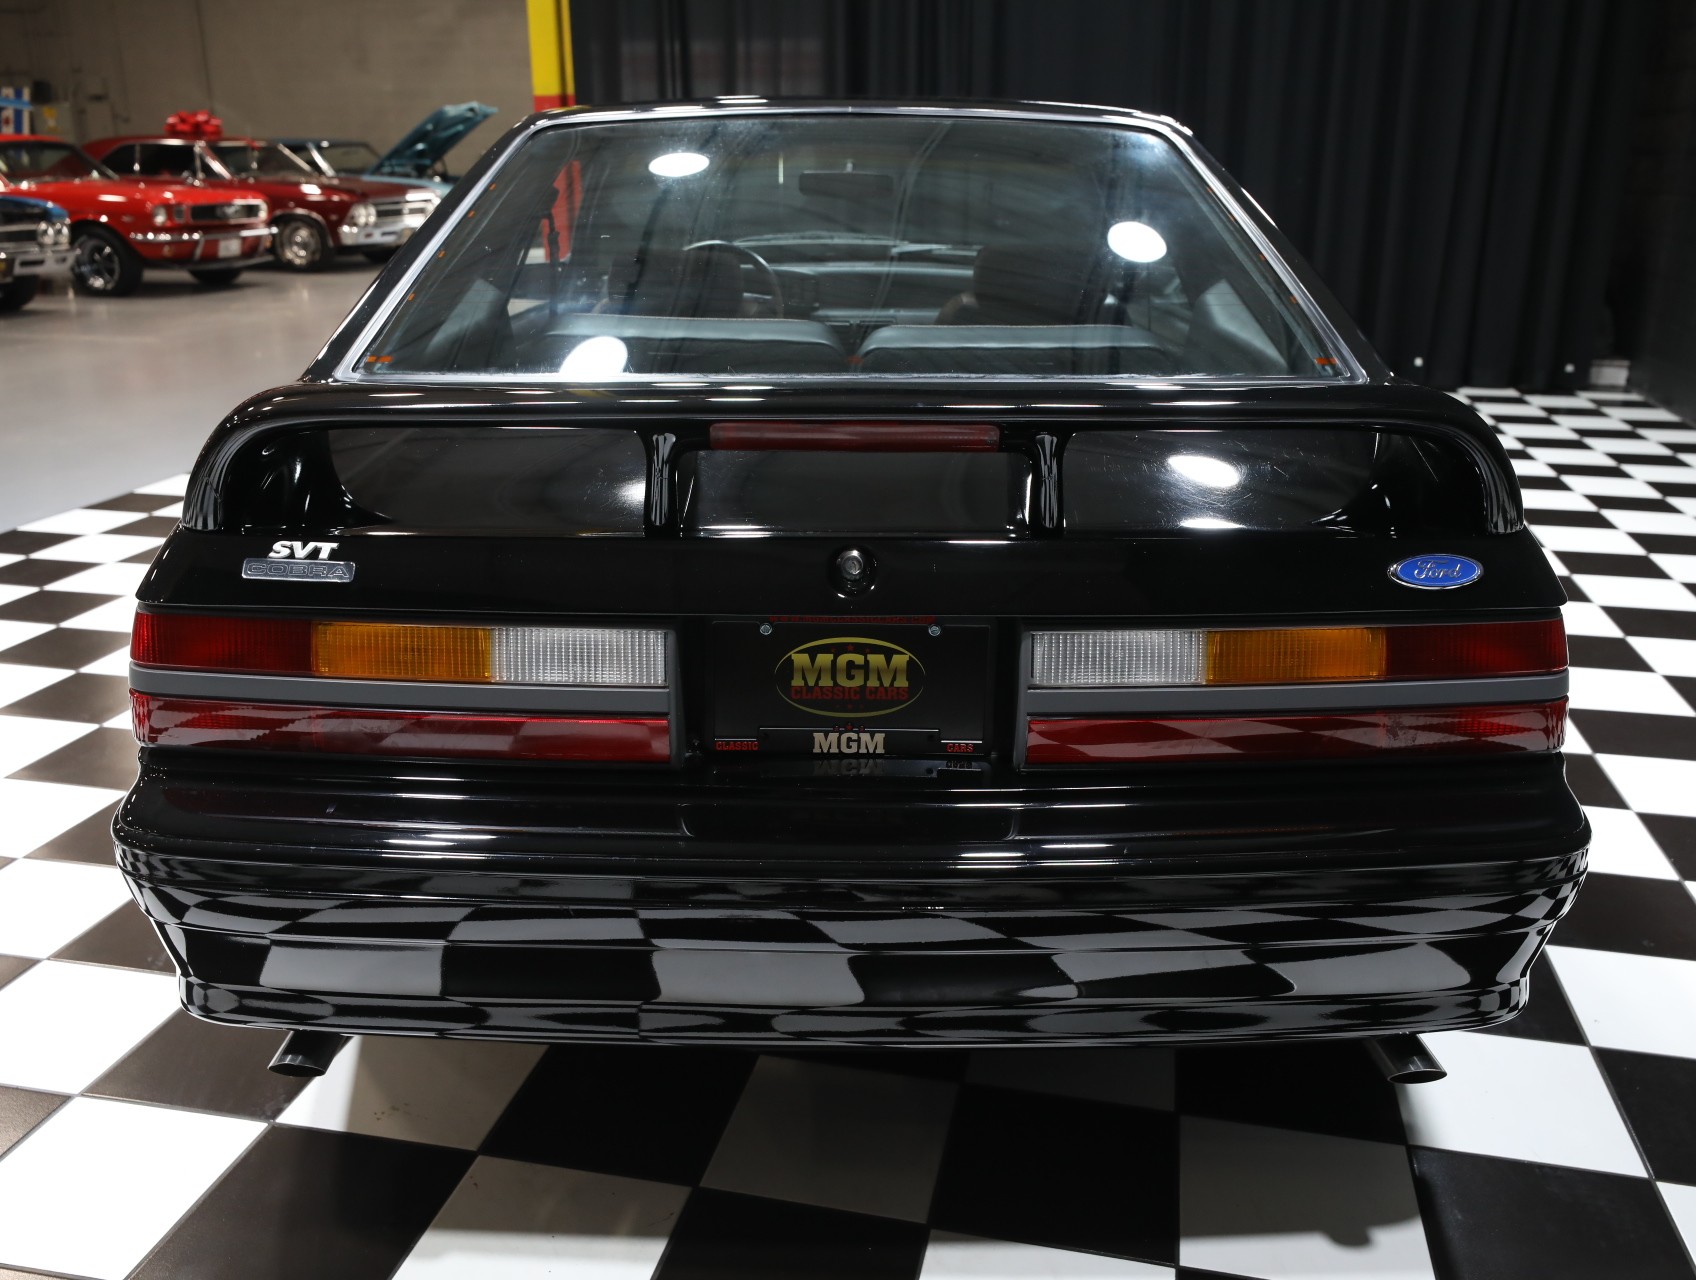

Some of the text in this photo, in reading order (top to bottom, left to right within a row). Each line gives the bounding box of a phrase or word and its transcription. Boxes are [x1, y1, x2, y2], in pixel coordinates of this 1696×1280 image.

[267, 540, 339, 560] SVT
[246, 563, 349, 578] COBRA
[1413, 559, 1462, 579] Ford
[791, 653, 909, 687] MGM
[791, 686, 909, 700] CLASSIC CARS
[715, 732, 975, 754] CLASSIC MGM CARS
